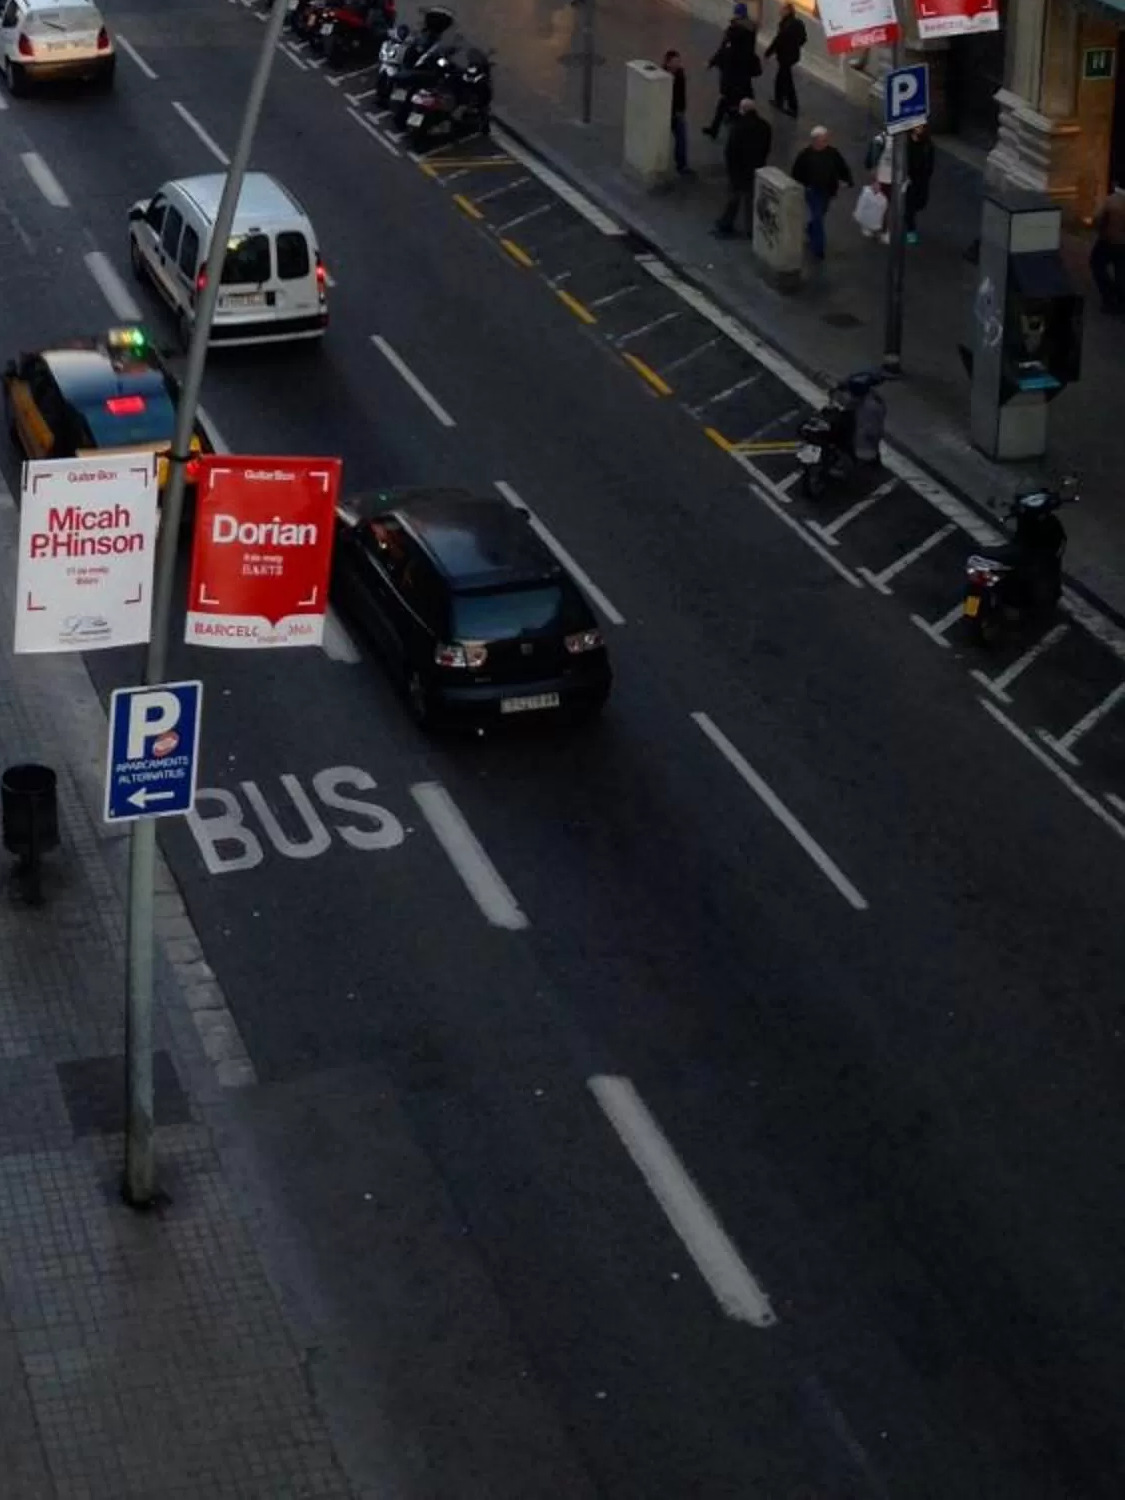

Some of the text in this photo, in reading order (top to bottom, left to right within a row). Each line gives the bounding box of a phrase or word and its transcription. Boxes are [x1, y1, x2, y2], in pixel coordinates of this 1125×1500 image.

[891, 73, 918, 117] P
[48, 503, 131, 533] Micah
[212, 513, 318, 545] Dorian
[126, 690, 181, 760] P
[115, 755, 189, 773] APARCAMENTS
[185, 765, 405, 875] BUS
